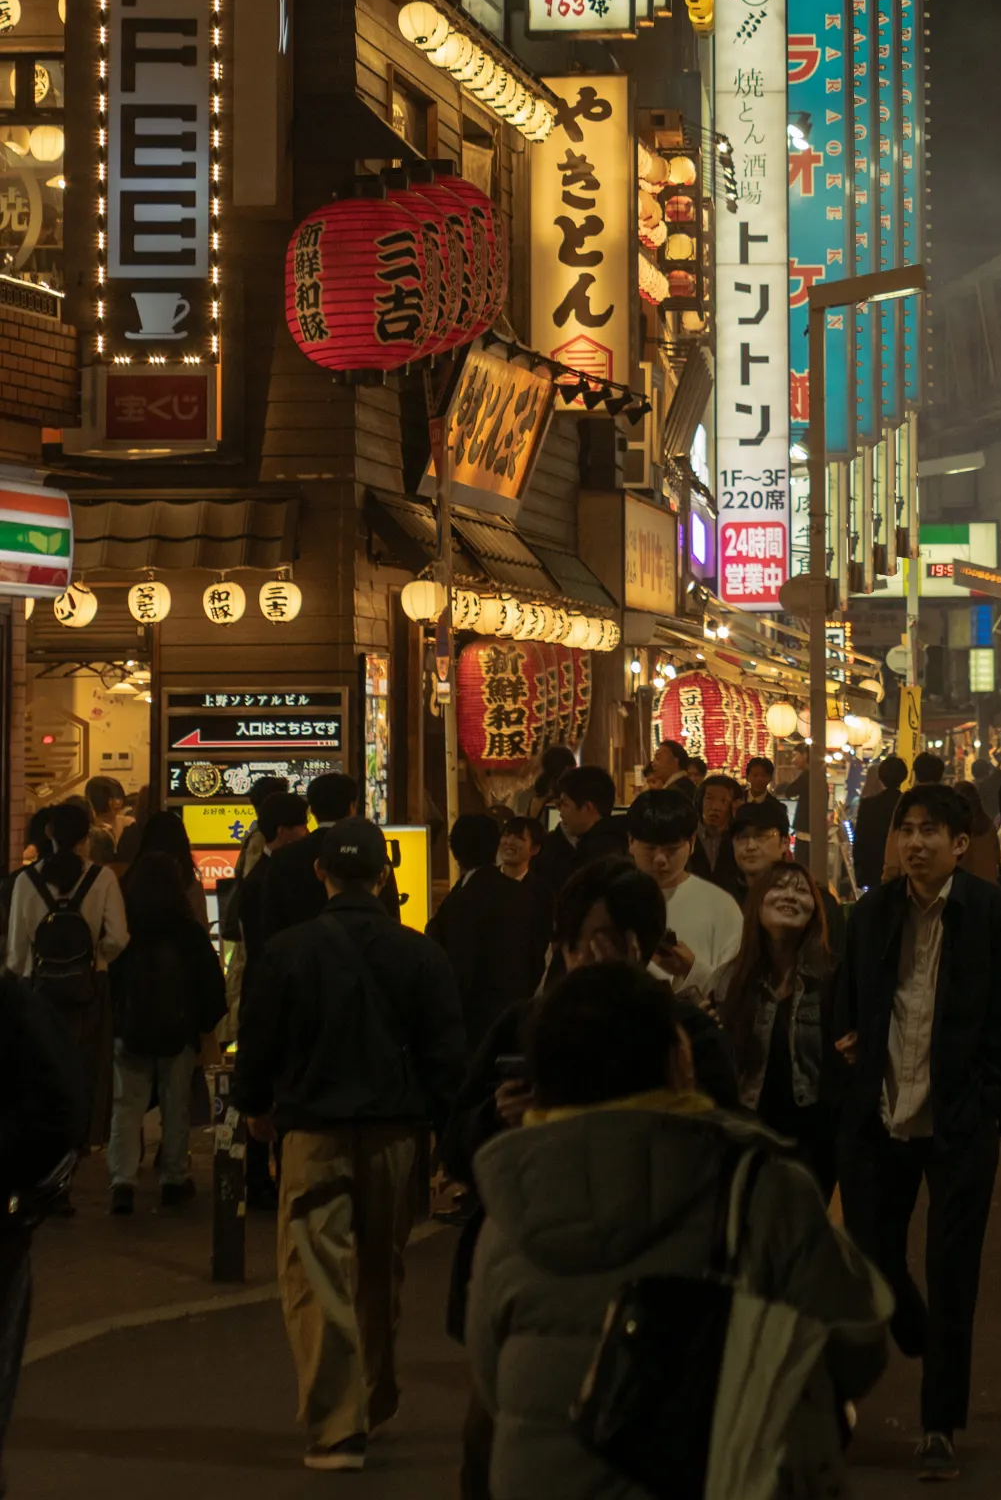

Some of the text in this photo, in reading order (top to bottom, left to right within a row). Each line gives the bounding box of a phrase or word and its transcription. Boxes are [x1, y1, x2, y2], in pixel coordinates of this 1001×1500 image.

[825, 13, 844, 331] KARAOKE KN
[551, 86, 615, 329] やきとん
[294, 219, 330, 343] 新鮮和豚
[374, 229, 426, 345] 三吉
[733, 221, 771, 447] トントン
[114, 394, 199, 423] 宝くじ
[721, 489, 786, 512] 220席
[724, 526, 785, 560] 24時間
[724, 563, 785, 597] 営業中
[208, 588, 234, 619] 和豚
[264, 587, 289, 618] 三吉
[202, 693, 310, 708] 上野ソシアルビル
[482, 644, 528, 759] 新鮮和豚
[236, 721, 339, 737] 入口はこちらです
